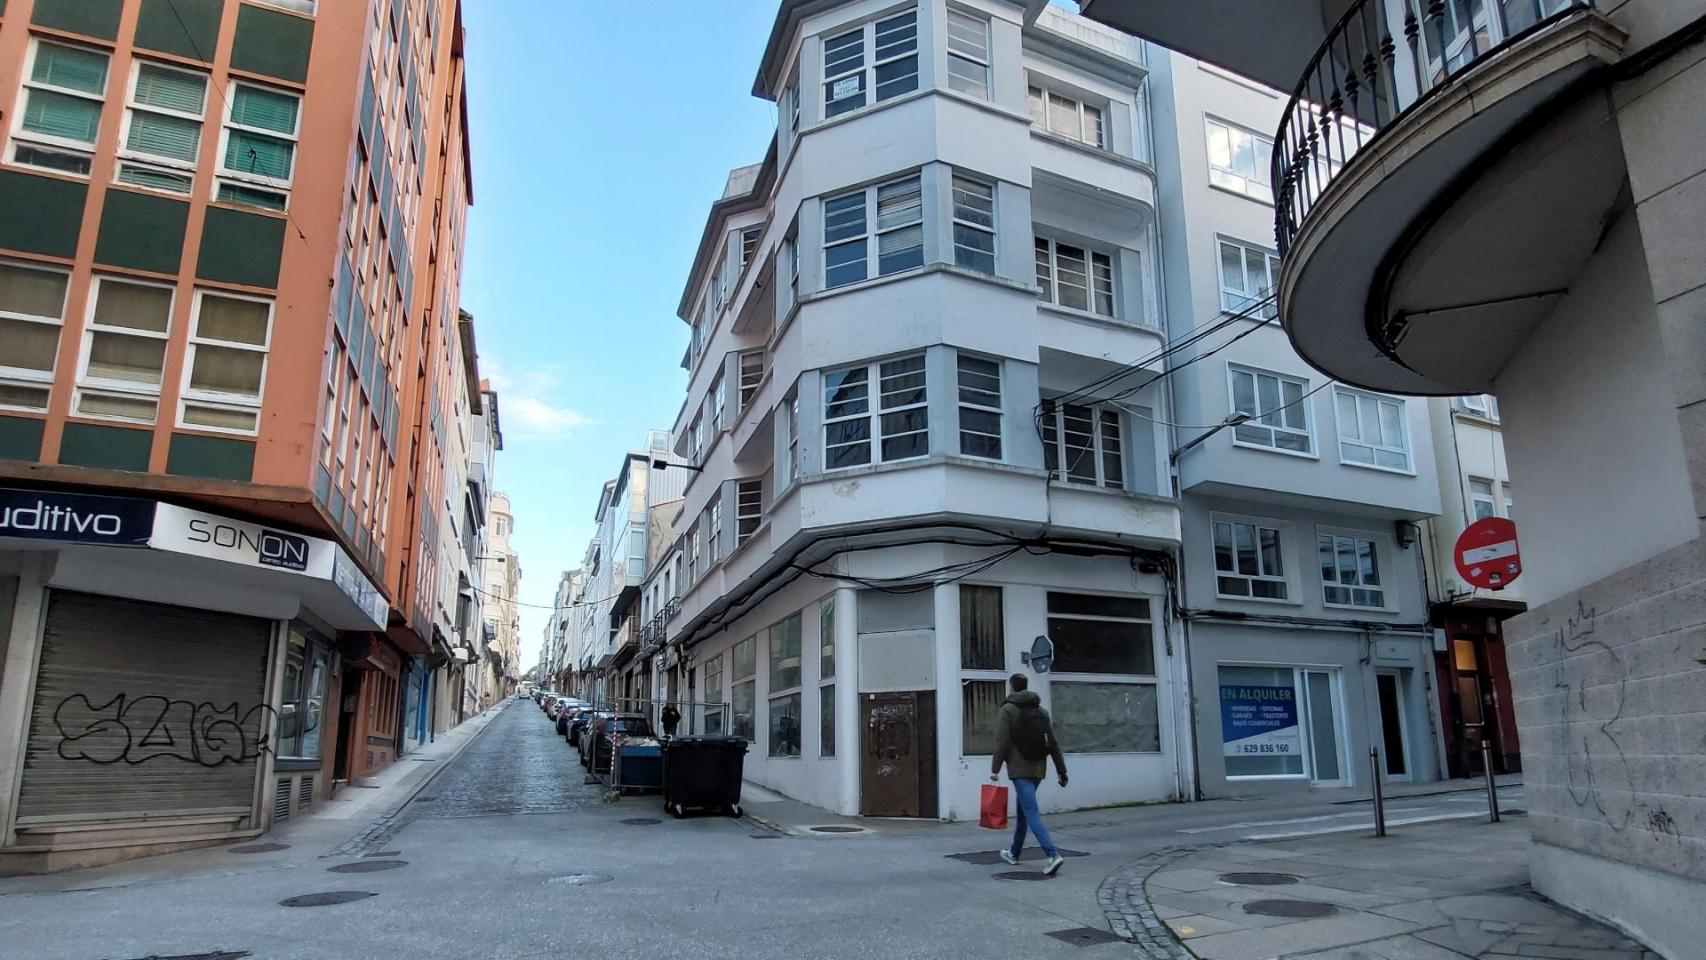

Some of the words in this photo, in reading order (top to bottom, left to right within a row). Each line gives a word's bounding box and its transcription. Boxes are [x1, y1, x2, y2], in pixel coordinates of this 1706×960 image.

[1221, 688, 1237, 700] EN
[1239, 688, 1292, 702] ALQUILER
[1243, 744, 1258, 753] 629
[1260, 744, 1274, 753] 836
[1276, 744, 1289, 753] 160
